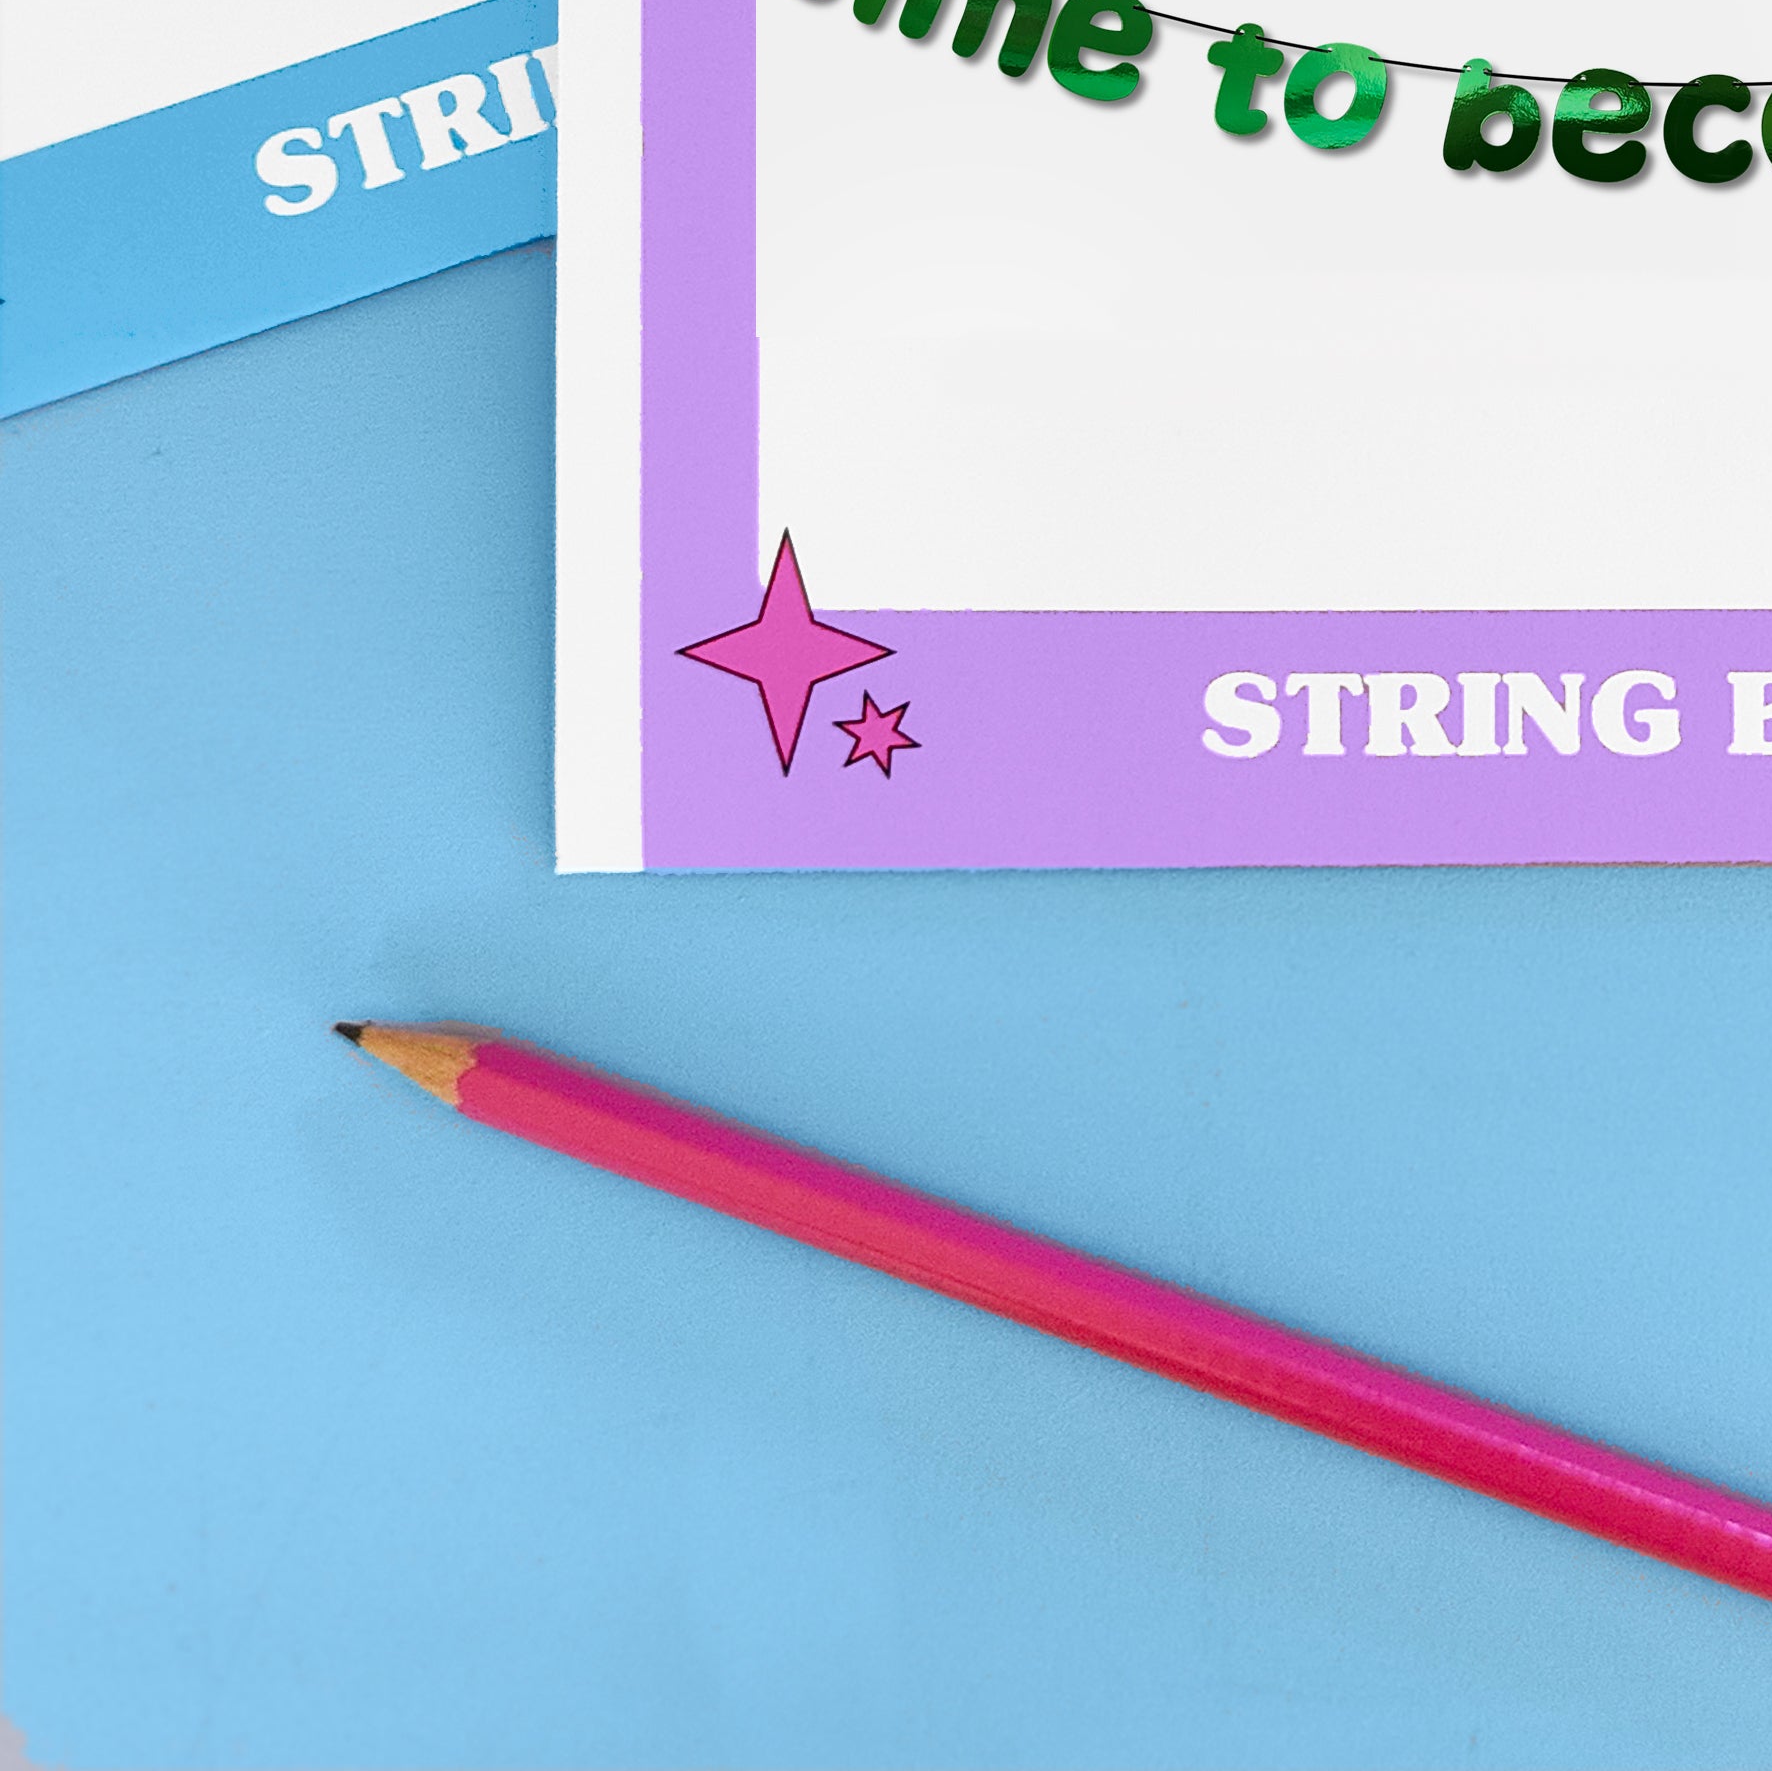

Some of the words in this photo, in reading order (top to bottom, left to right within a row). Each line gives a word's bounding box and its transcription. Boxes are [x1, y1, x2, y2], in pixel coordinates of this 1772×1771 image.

[255, 44, 558, 217] STRI
[1207, 22, 1388, 150] to
[1202, 670, 1682, 758] STRING
